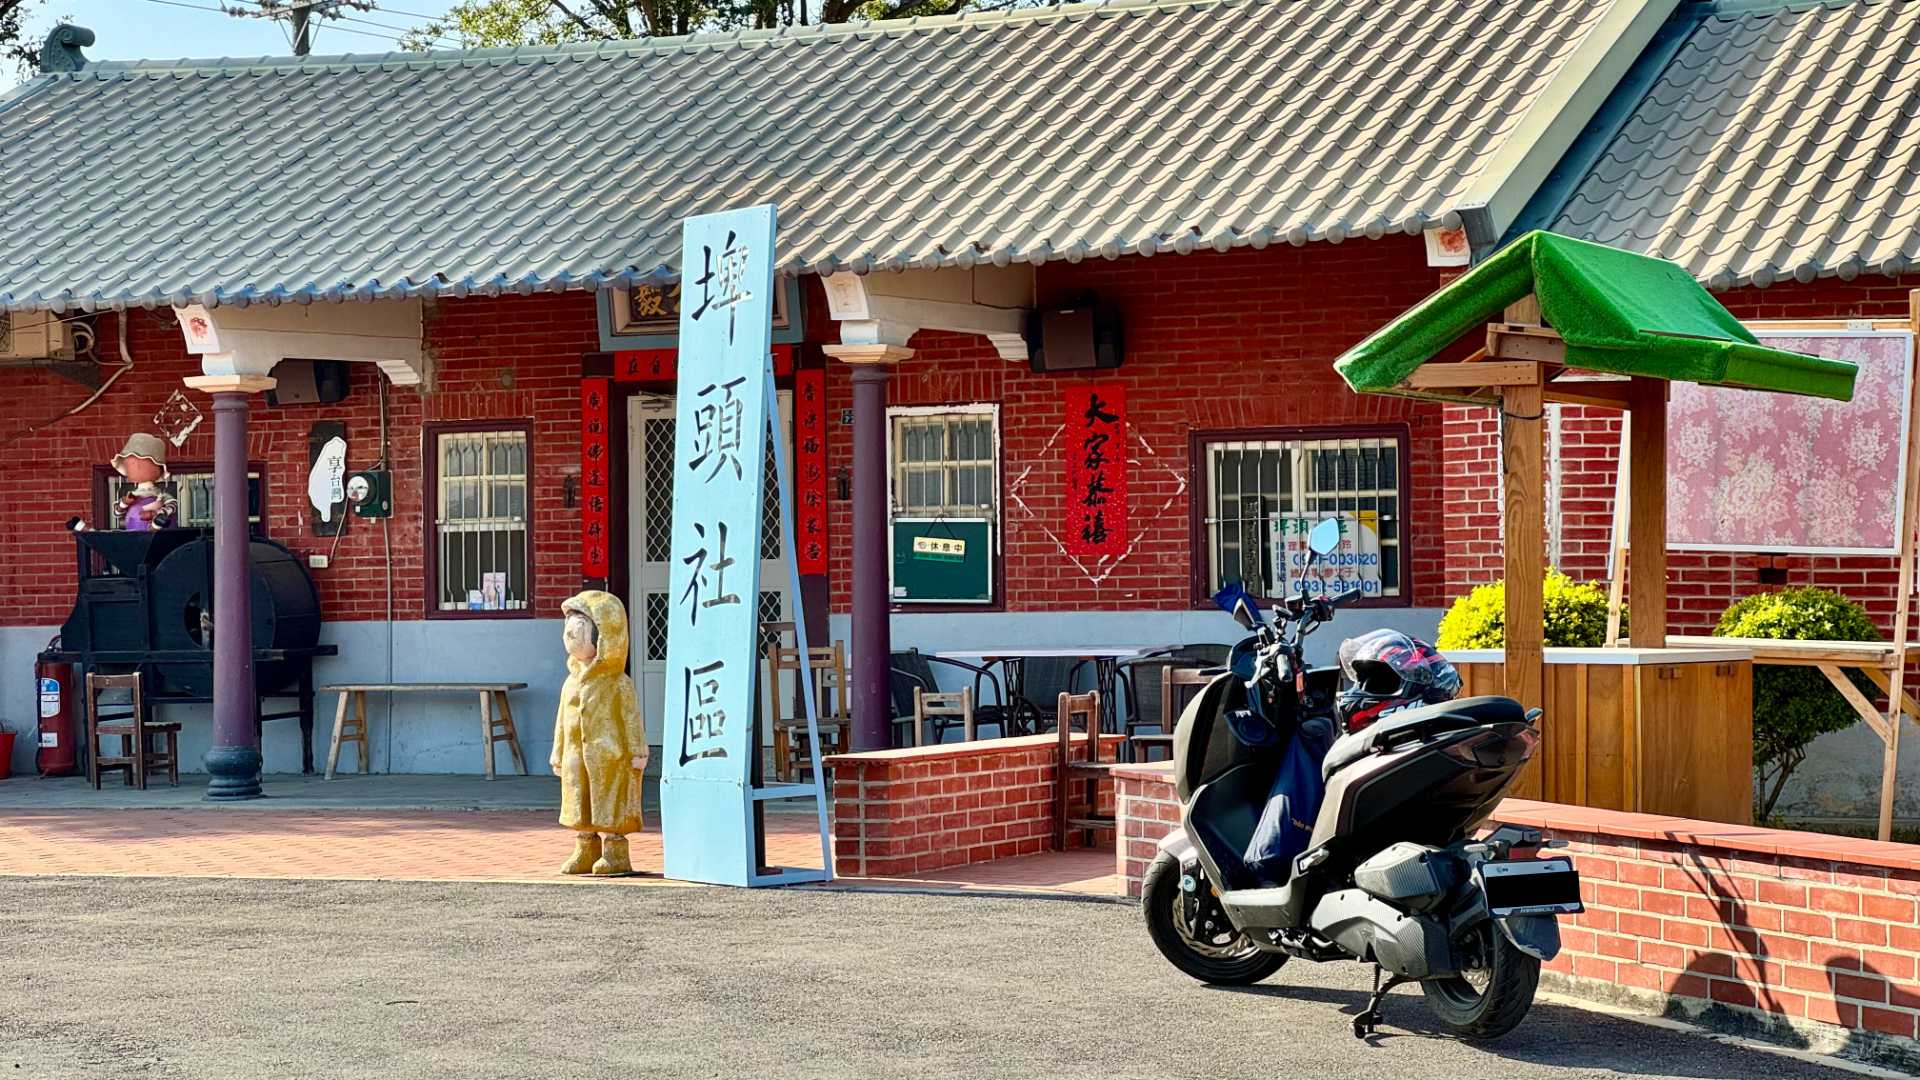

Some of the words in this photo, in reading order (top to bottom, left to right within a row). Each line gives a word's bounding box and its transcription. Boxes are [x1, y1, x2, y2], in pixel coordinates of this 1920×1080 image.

[328, 455, 343, 500] 享台灣
[679, 230, 754, 767] 埤頭社區
